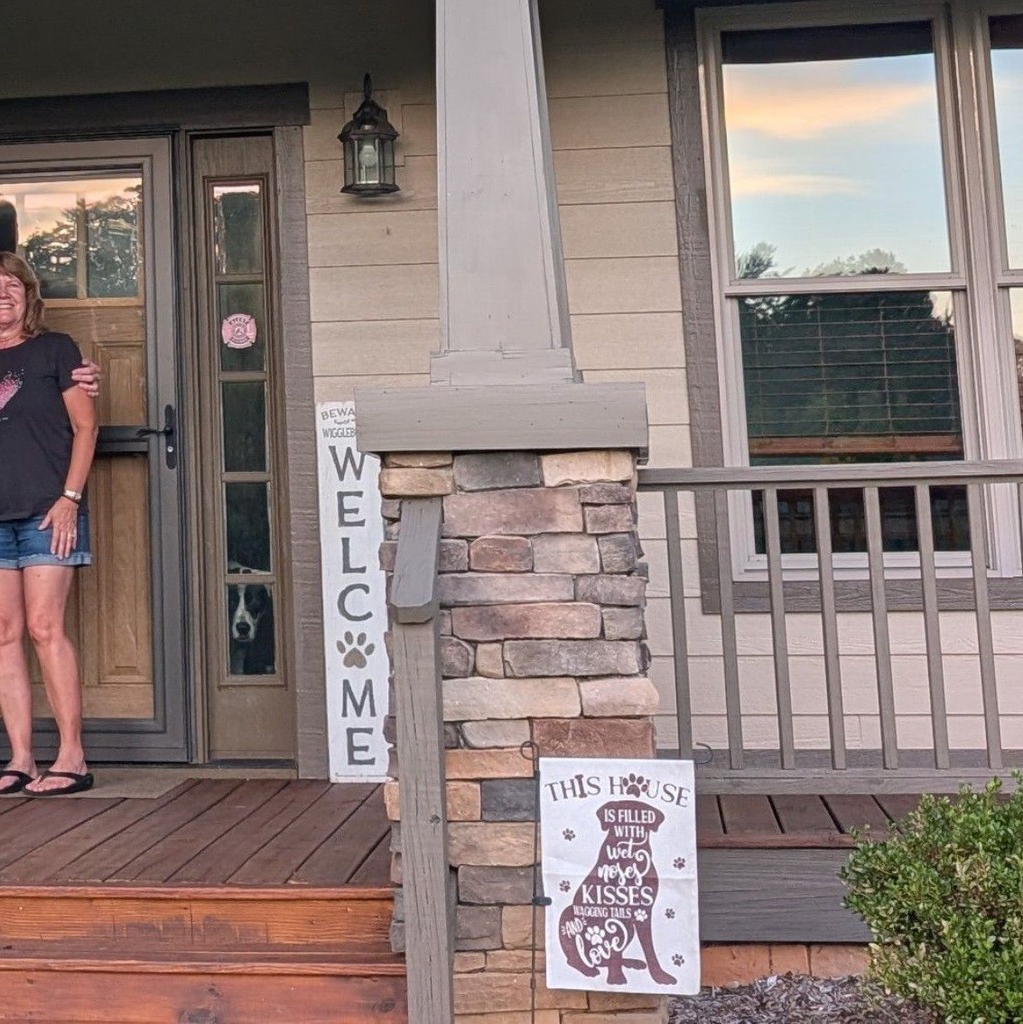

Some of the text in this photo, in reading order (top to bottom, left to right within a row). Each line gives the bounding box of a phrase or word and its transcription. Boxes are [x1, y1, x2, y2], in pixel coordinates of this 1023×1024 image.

[544, 774, 601, 802] THIS
[604, 809, 656, 824] IS FILLED
[614, 825, 645, 838] WITH
[606, 836, 642, 860] wet
[598, 856, 649, 886] noses
[582, 884, 654, 906] KISSES
[573, 905, 632, 919] WAGGING TAILS
[565, 917, 584, 939] AND
[575, 926, 628, 968] love
